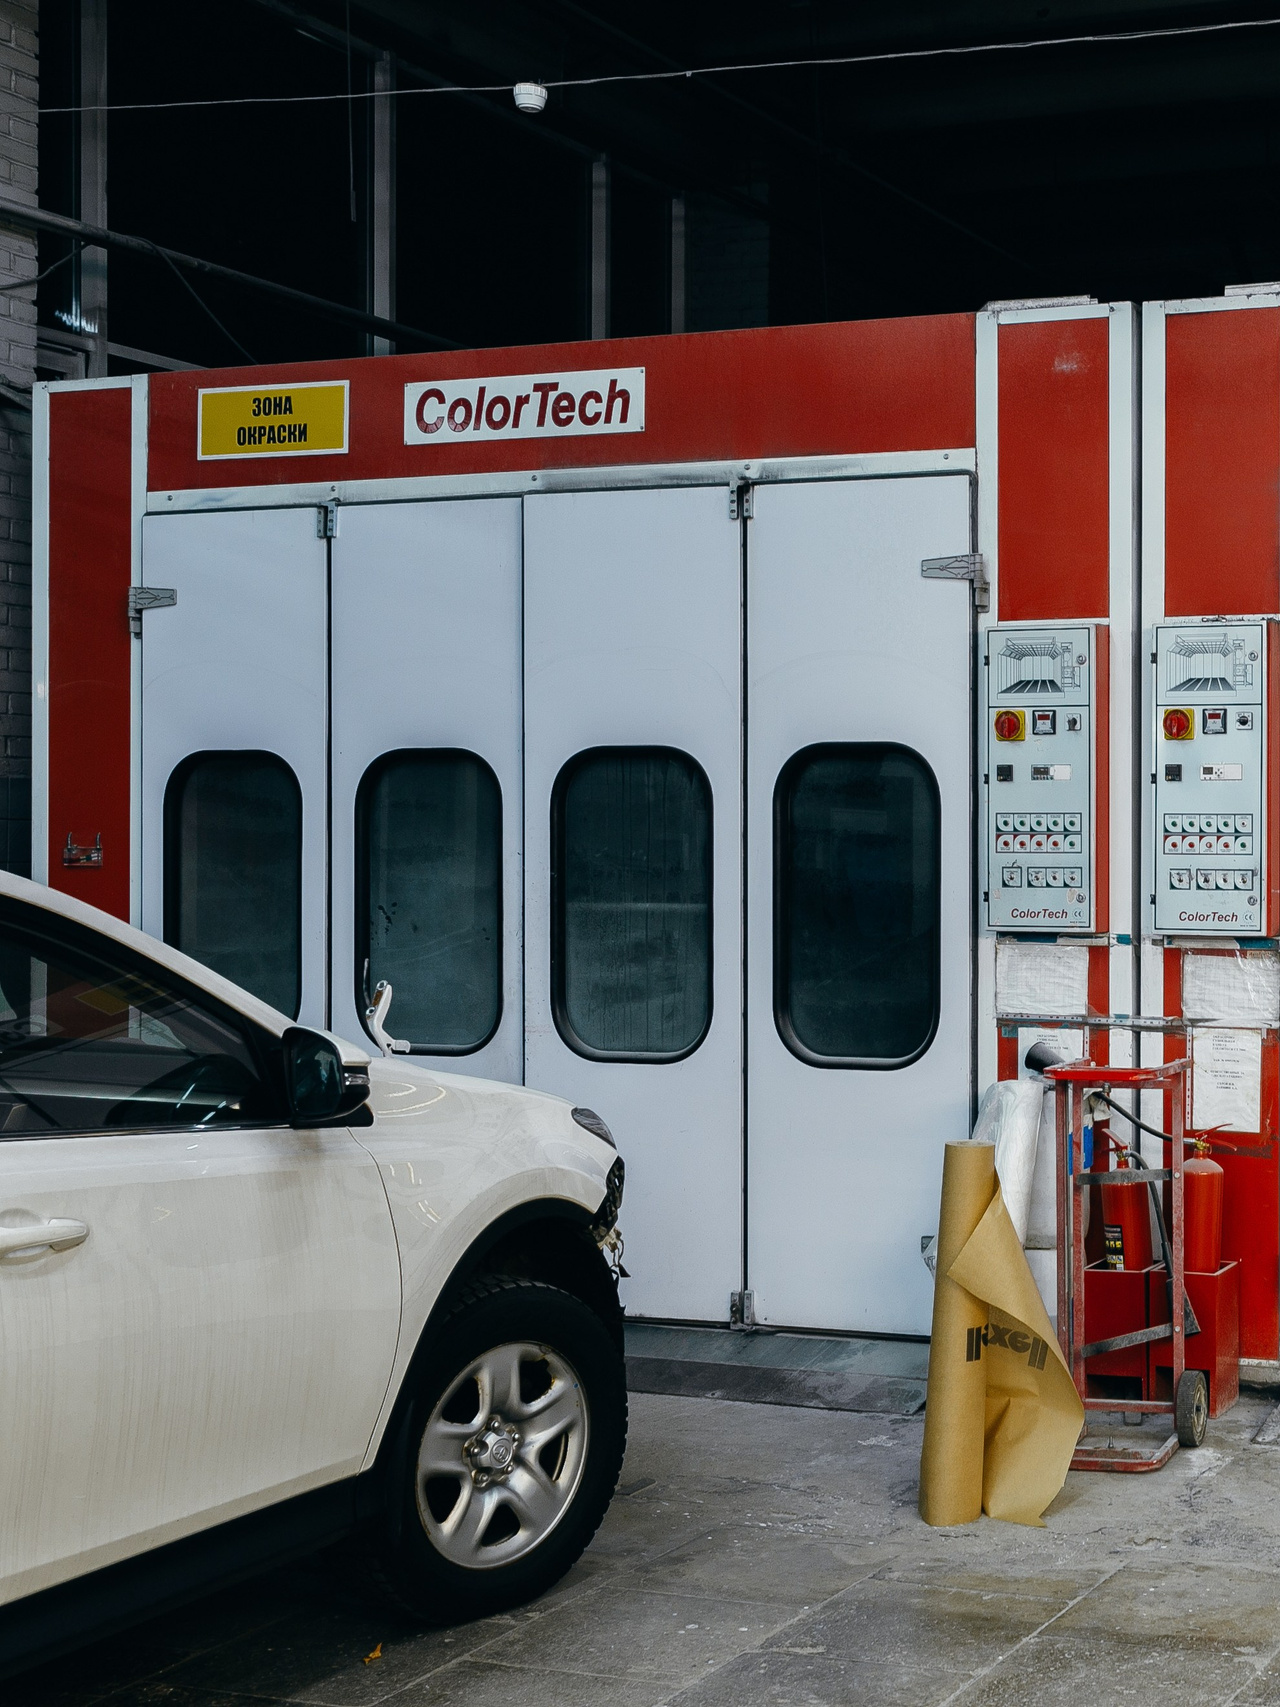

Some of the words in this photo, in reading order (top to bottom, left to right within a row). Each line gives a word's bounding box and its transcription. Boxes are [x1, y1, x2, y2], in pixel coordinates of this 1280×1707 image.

[251, 395, 294, 418] ЗОНА
[415, 378, 631, 434] ColorTech
[236, 423, 308, 446] ОКРАСКИ
[1011, 908, 1068, 919] ColorTech
[1178, 911, 1238, 922] ColorTech
